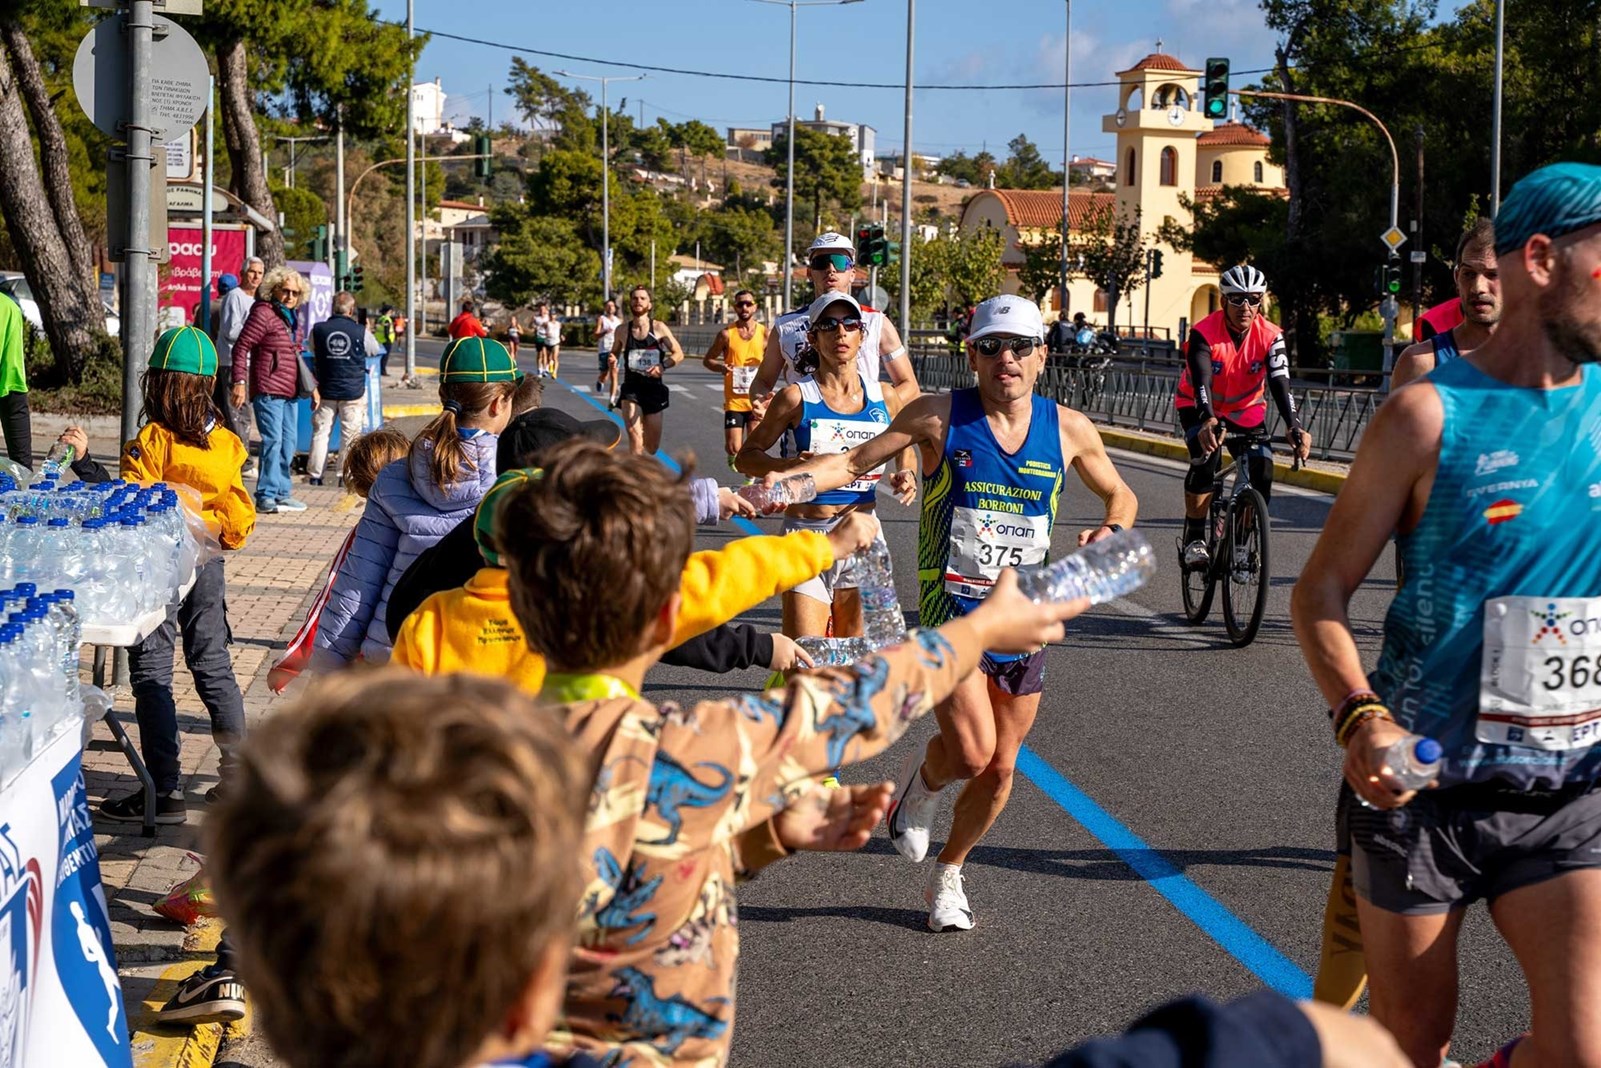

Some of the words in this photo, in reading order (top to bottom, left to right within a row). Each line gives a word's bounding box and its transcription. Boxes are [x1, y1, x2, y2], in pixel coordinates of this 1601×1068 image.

[176, 188, 203, 196] ΡΑΦΗΝΑ
[963, 481, 1043, 501] ASSICURAZIONI
[978, 498, 1024, 514] BORRONI
[979, 544, 1023, 567] 375
[218, 982, 246, 1000] NIK
